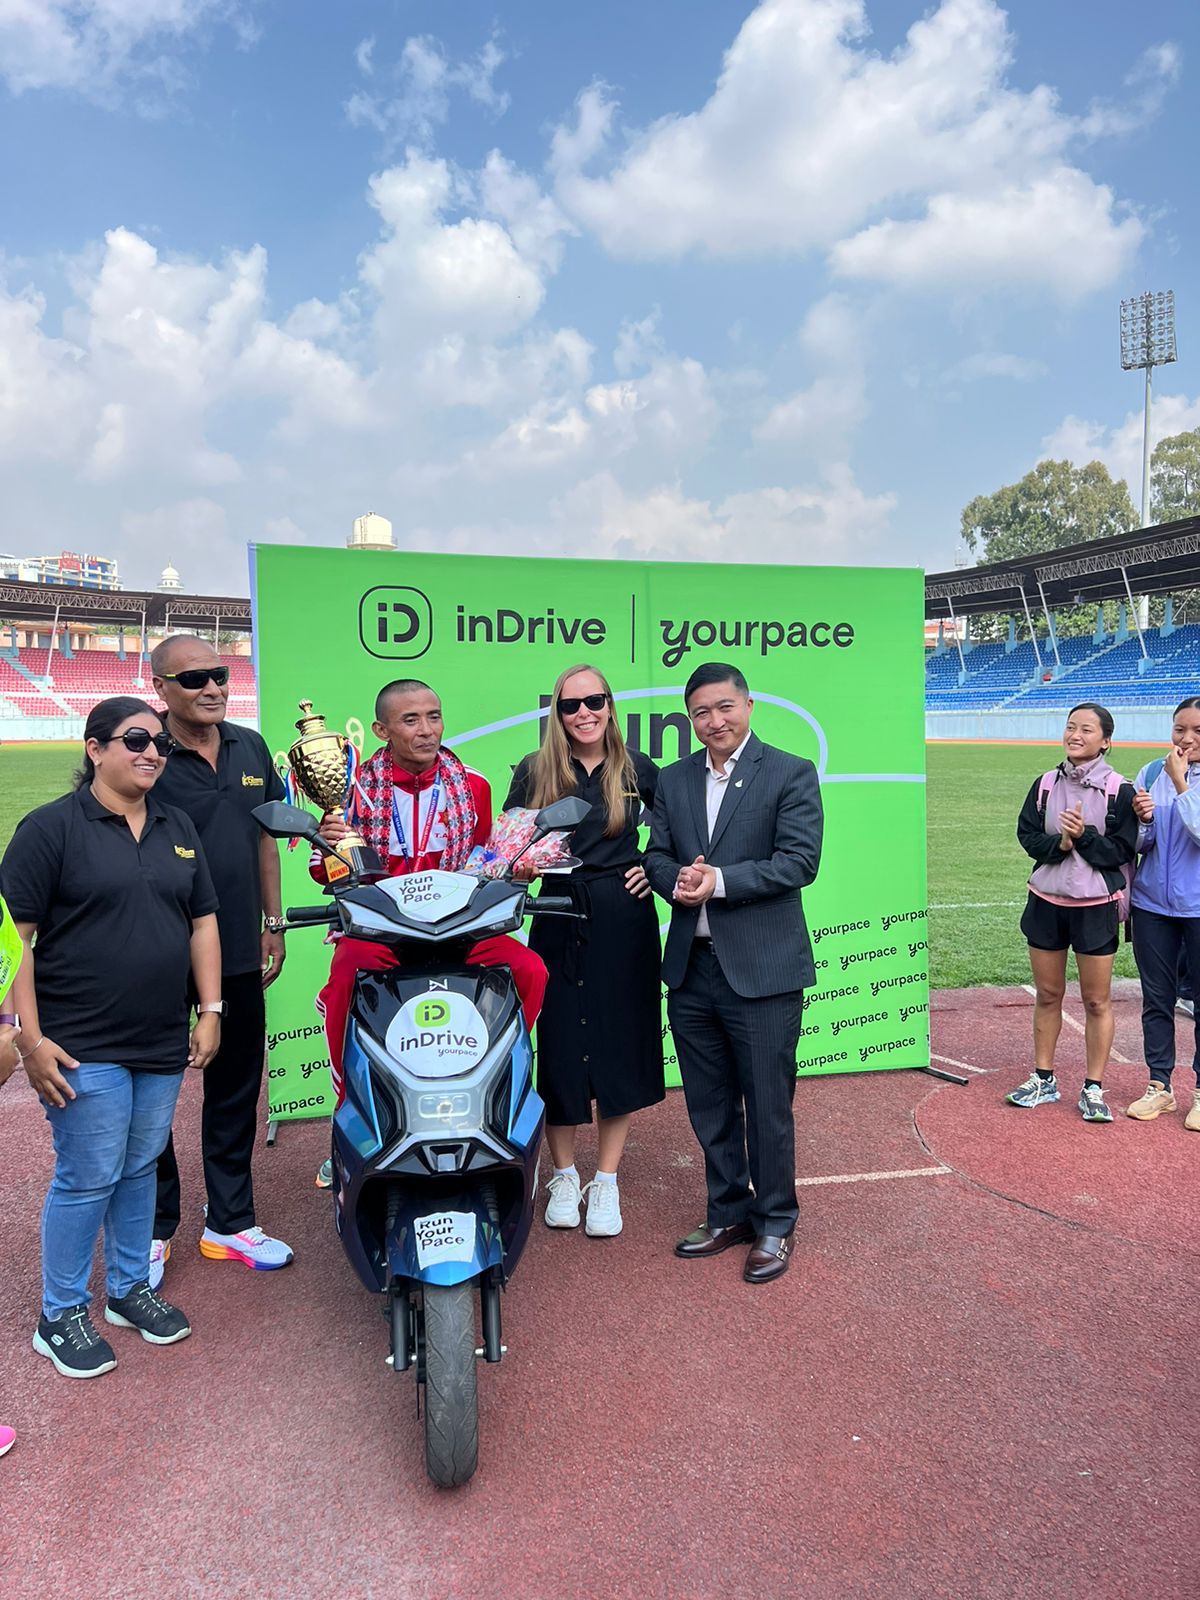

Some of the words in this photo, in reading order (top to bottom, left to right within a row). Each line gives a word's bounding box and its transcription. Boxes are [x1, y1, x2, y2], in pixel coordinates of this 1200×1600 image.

[457, 605, 606, 645] inDrive
[660, 620, 855, 668] yourpace
[399, 883, 433, 895] Your
[403, 875, 433, 886] Run
[403, 893, 441, 904] Pace
[812, 919, 870, 943] yourpace
[839, 946, 897, 970] yourpace
[870, 972, 927, 996] yourpace
[831, 1011, 889, 1036] yourpace
[400, 1030, 478, 1052] inDrive
[858, 1036, 916, 1061] yourpace
[438, 1049, 478, 1057] yourpace
[416, 1226, 454, 1240] Your
[420, 1217, 453, 1229] Run
[422, 1236, 464, 1251] Pace
